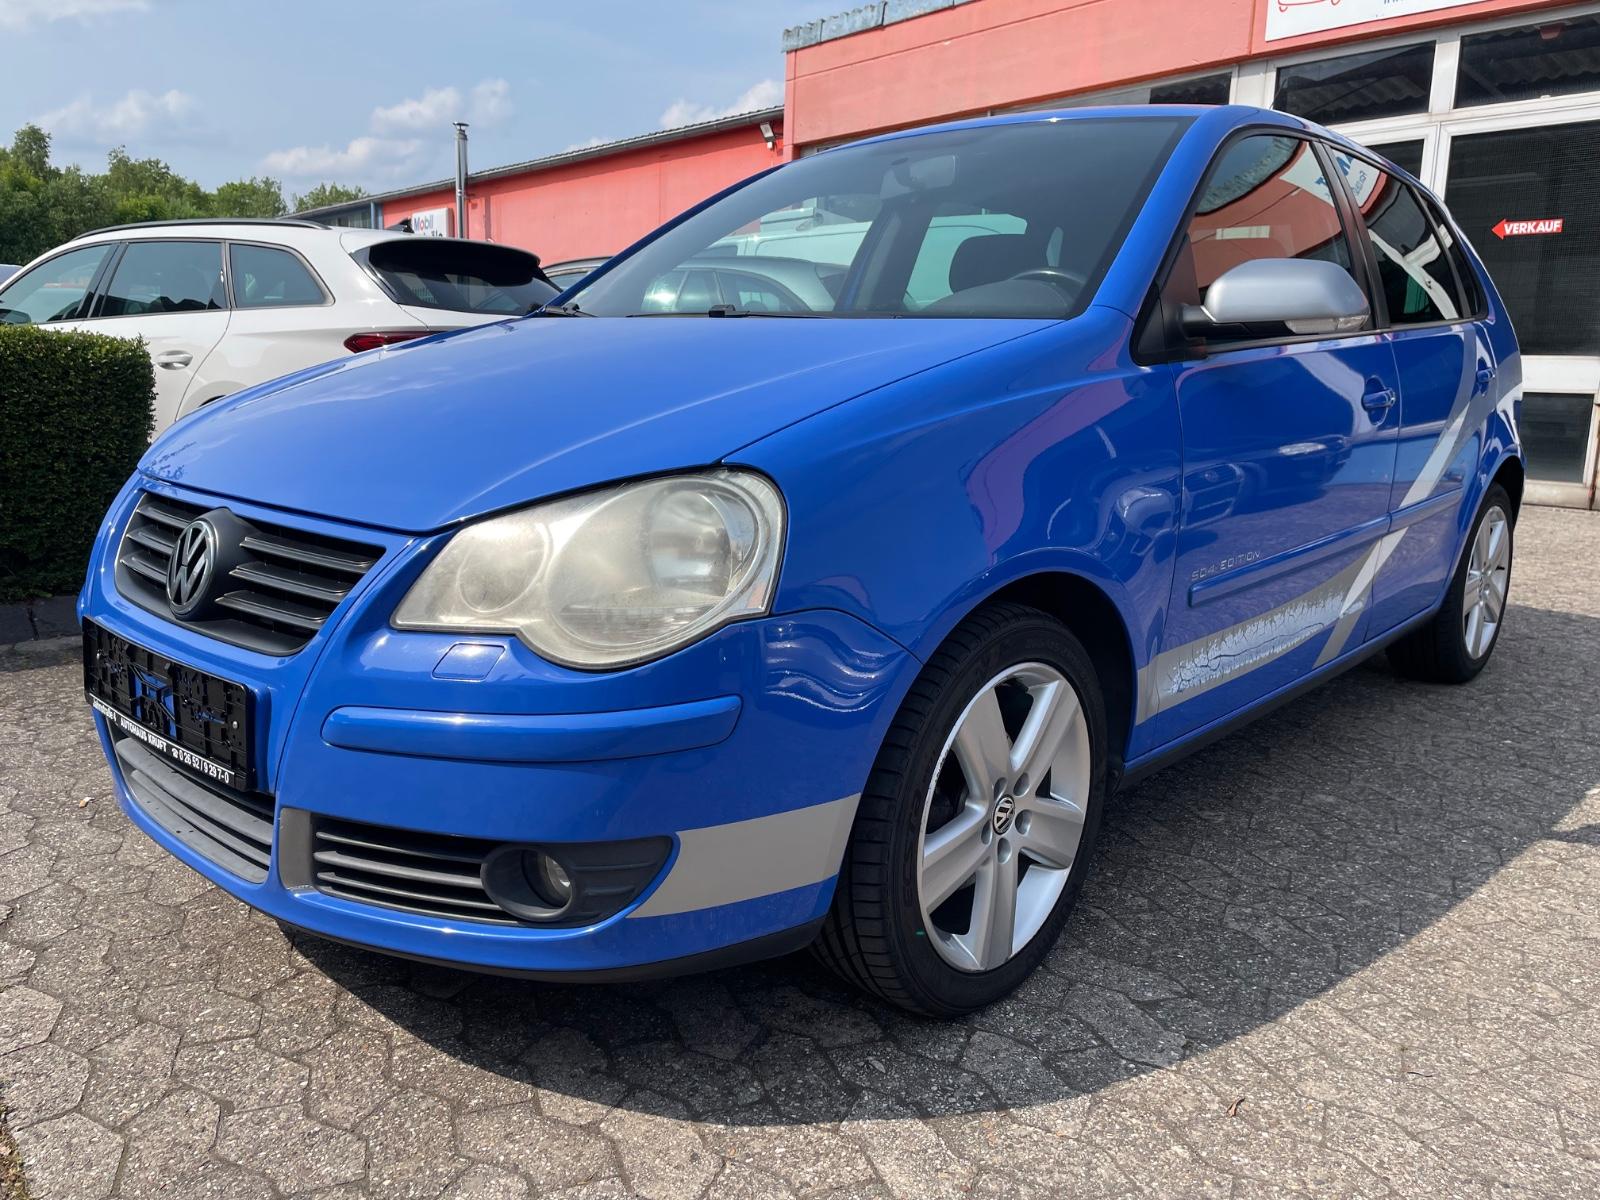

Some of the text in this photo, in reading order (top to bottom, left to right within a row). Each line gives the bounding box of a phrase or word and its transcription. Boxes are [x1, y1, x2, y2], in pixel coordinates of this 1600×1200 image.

[414, 215, 433, 231] Mobil
[1504, 220, 1561, 235] VERKAUF
[1220, 551, 1261, 571] EDITION
[120, 717, 147, 742] AUTOHAUS
